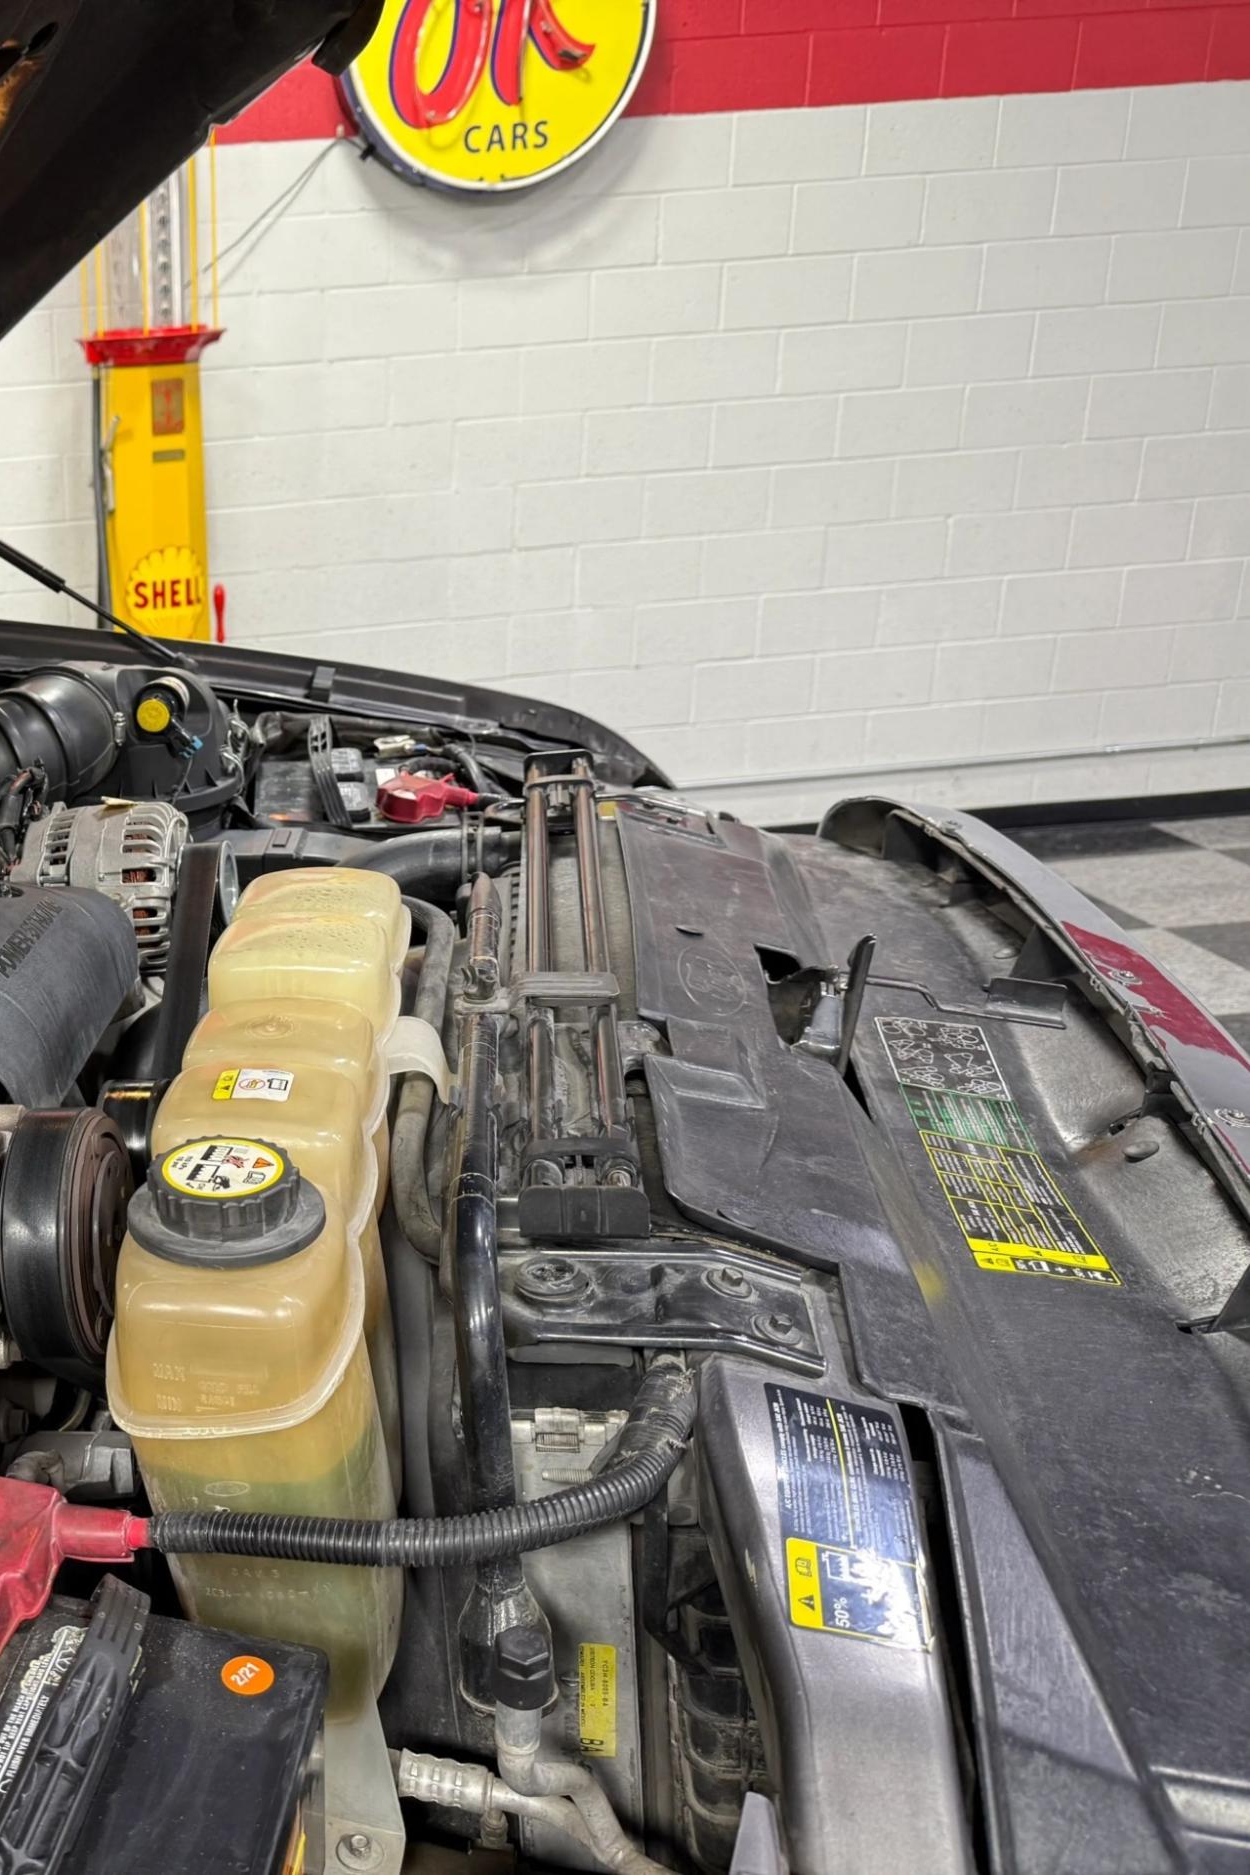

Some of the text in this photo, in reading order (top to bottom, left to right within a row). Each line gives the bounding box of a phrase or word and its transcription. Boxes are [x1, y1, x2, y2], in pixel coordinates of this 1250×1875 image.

[463, 120, 549, 154] CARS
[133, 578, 202, 610] SHELL
[833, 1597, 850, 1628] 50%
[230, 1662, 260, 1686] 2/21
